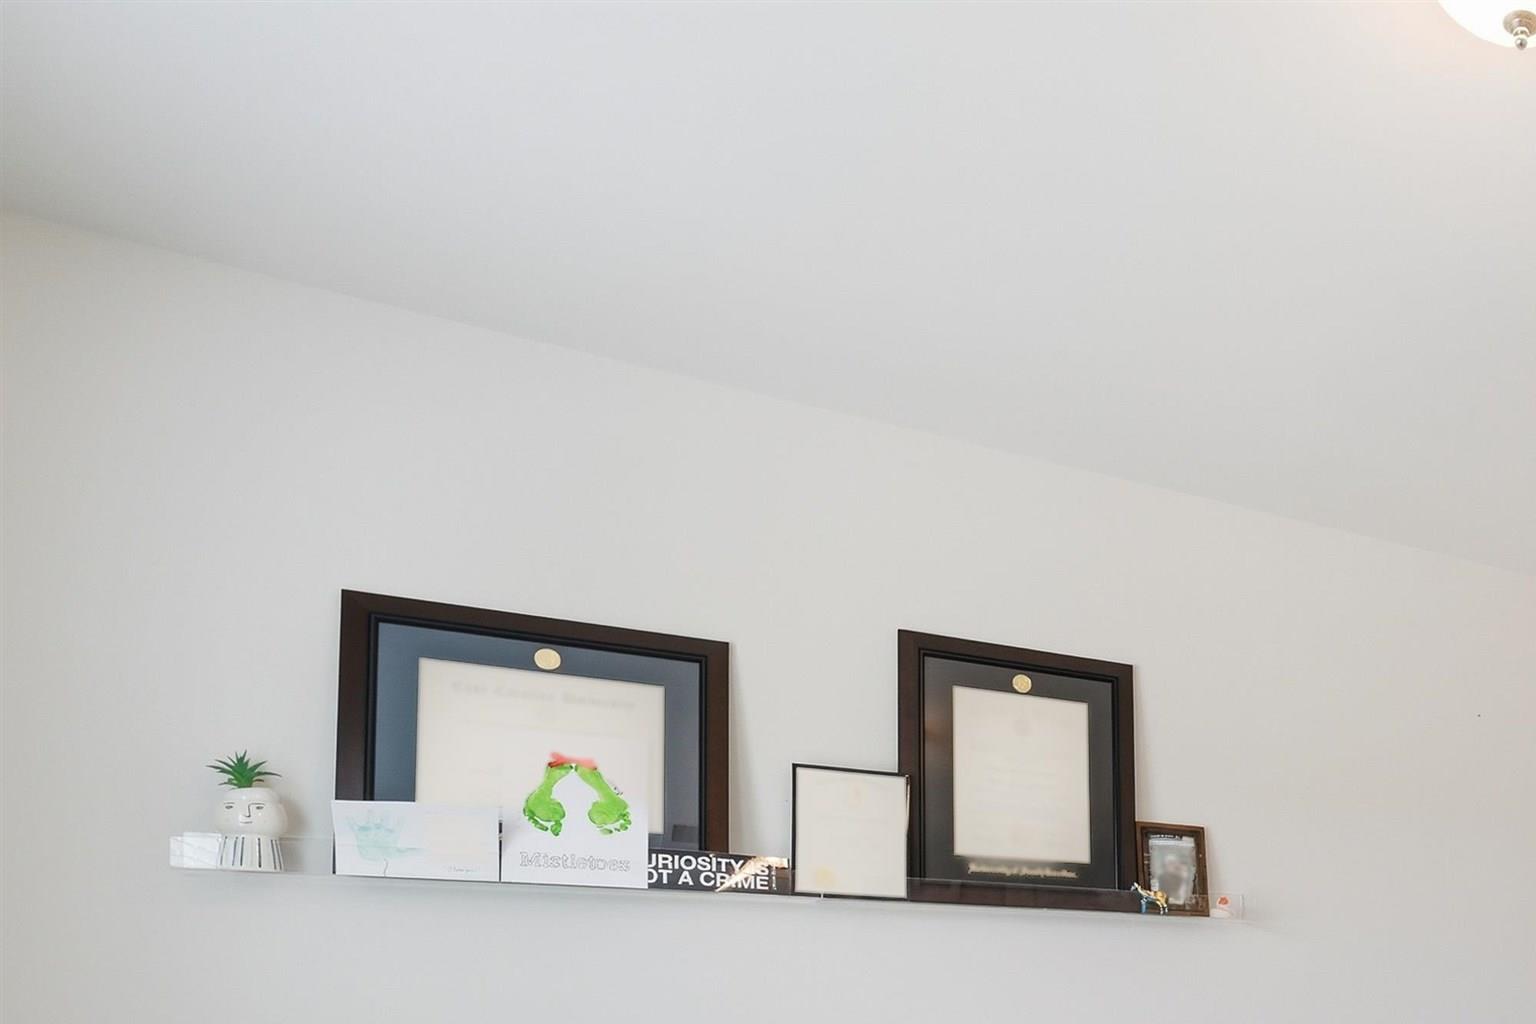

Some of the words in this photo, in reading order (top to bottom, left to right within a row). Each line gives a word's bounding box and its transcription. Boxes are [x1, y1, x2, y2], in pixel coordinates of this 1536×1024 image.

[648, 853, 745, 873] URIOSITY
[648, 868, 673, 884] OT
[678, 870, 694, 886] A
